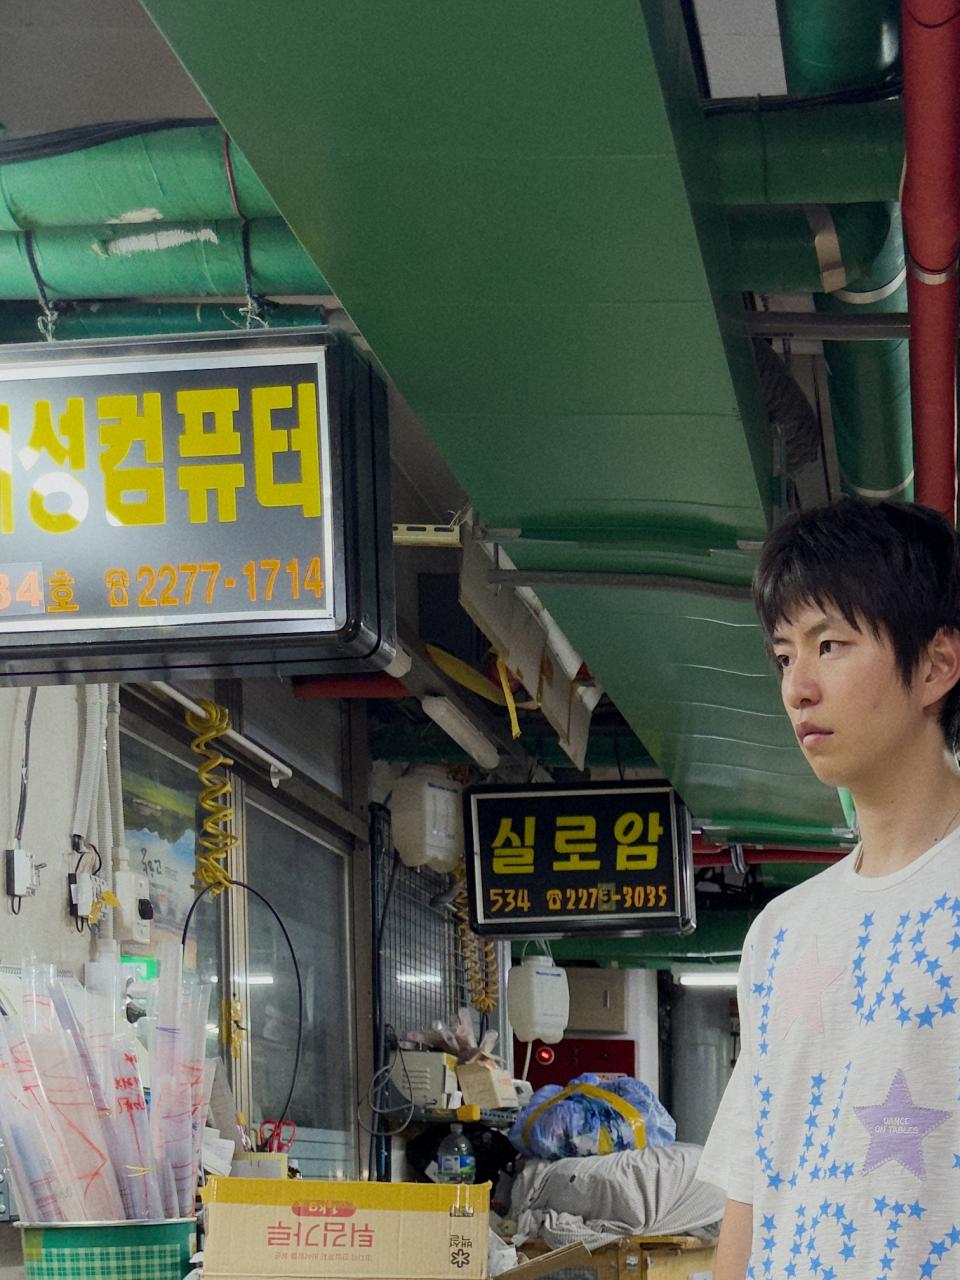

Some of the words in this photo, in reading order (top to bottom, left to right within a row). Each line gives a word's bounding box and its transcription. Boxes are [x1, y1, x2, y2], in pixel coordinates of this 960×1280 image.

[136, 556, 324, 607] 2277-1714
[490, 811, 664, 875] 실로암
[489, 888, 532, 913] 534
[266, 1219, 376, 1249] 튀김가루
